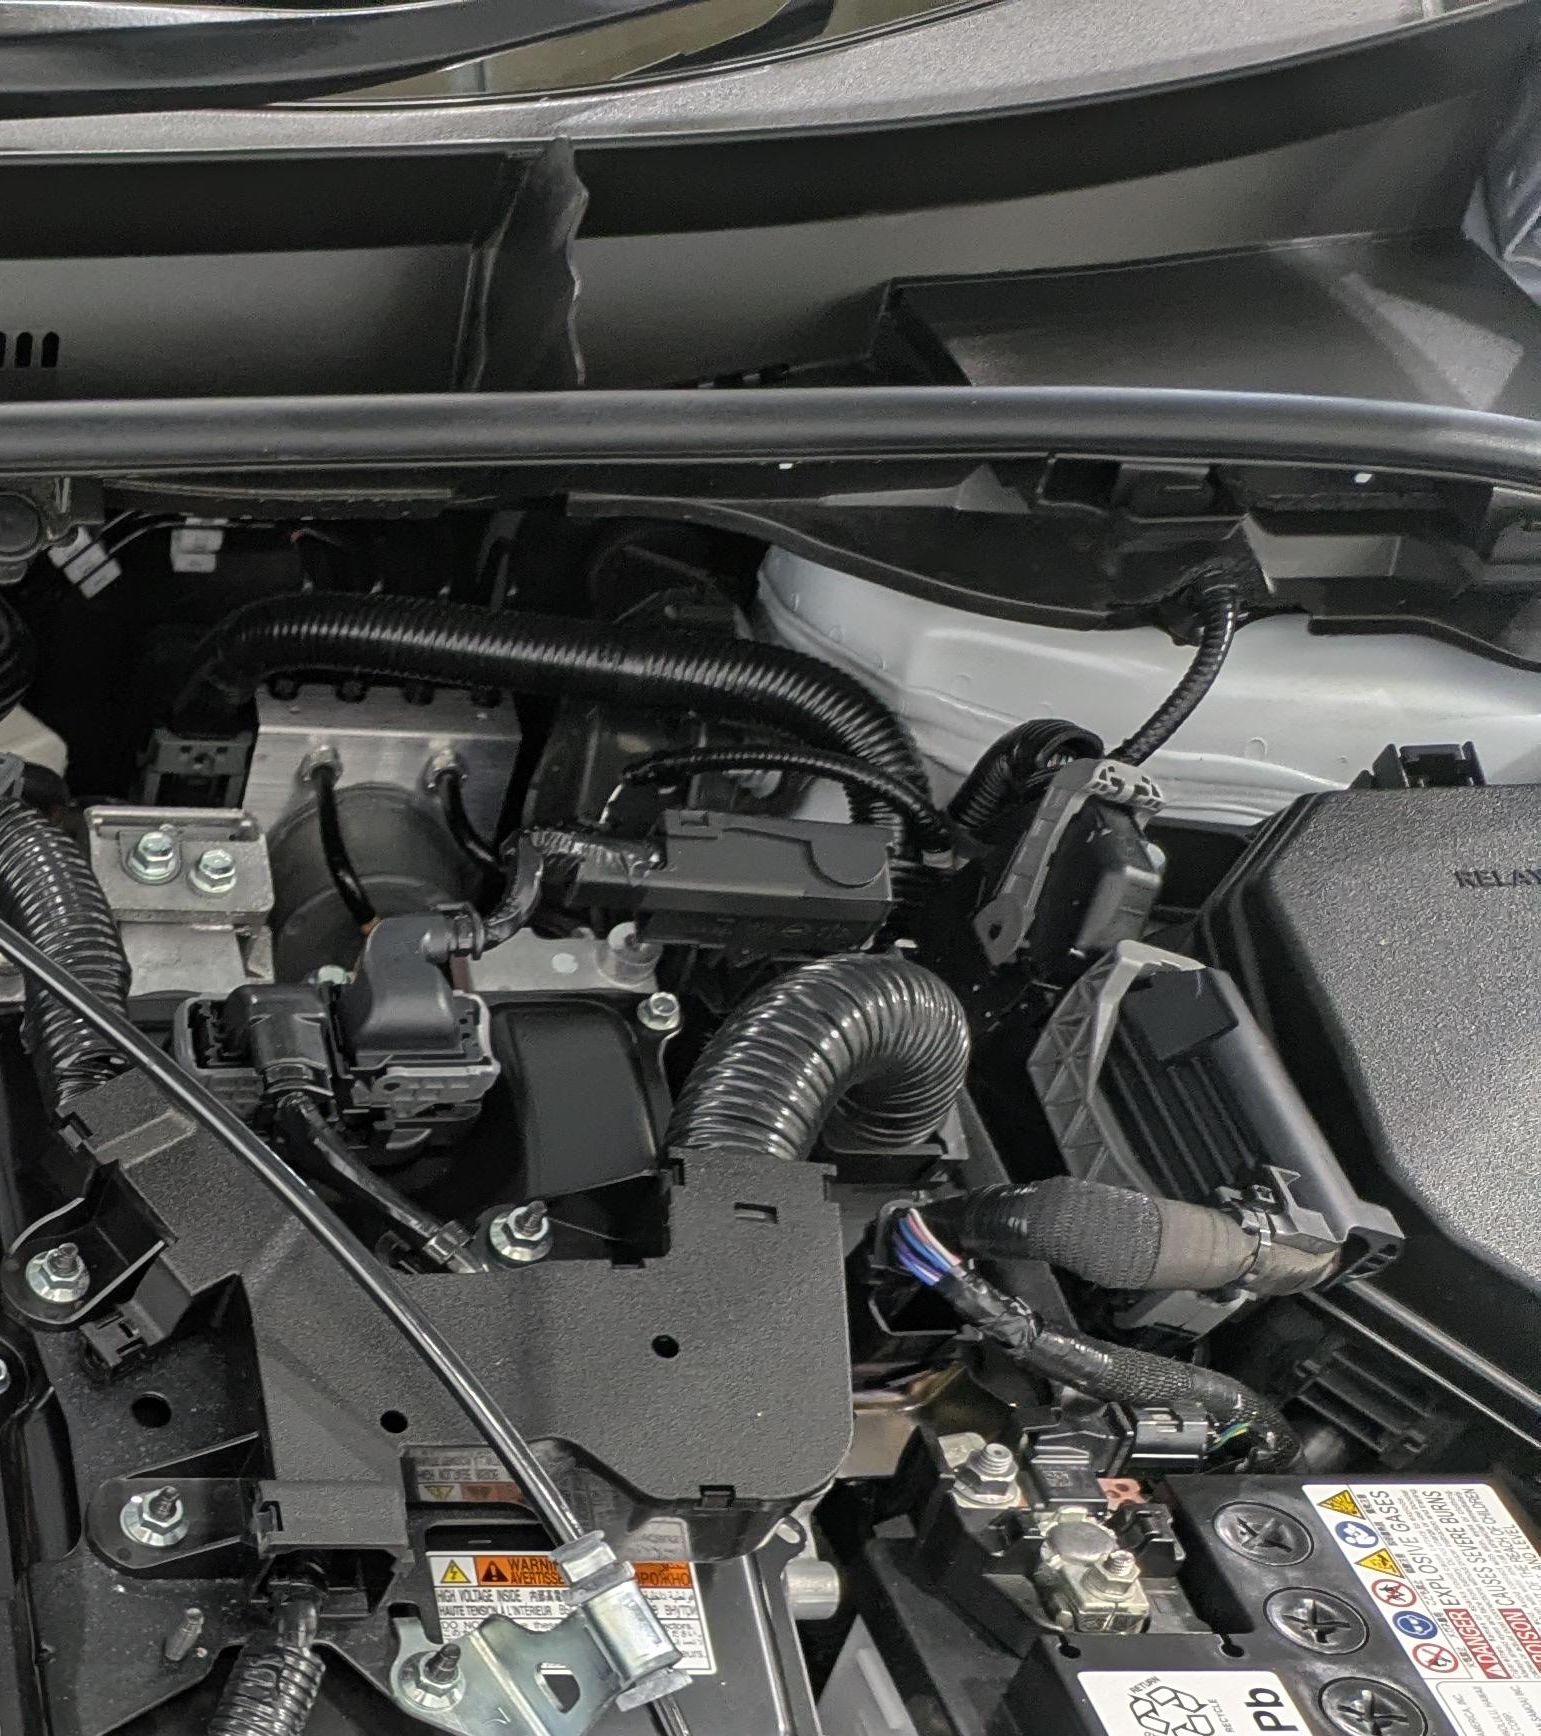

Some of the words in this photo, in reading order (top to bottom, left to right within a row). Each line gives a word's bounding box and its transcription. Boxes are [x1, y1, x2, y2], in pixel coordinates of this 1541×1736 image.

[1366, 1490, 1412, 1532] GASES
[1419, 1490, 1460, 1523] BURNS
[1444, 1527, 1488, 1562] SEVERE
[636, 1572, 690, 1586] РОЖНО
[1397, 1536, 1461, 1605] EXPLOSIVE
[1471, 1566, 1515, 1605] CAUSES
[438, 1589, 455, 1602] HIGH
[459, 1589, 494, 1602] VOLTAGE
[497, 1589, 521, 1602] INSIDE
[1445, 1611, 1500, 1663] DANGER
[1207, 1699, 1236, 1733] RECYCLE
[1244, 1688, 1300, 1732] Pb
